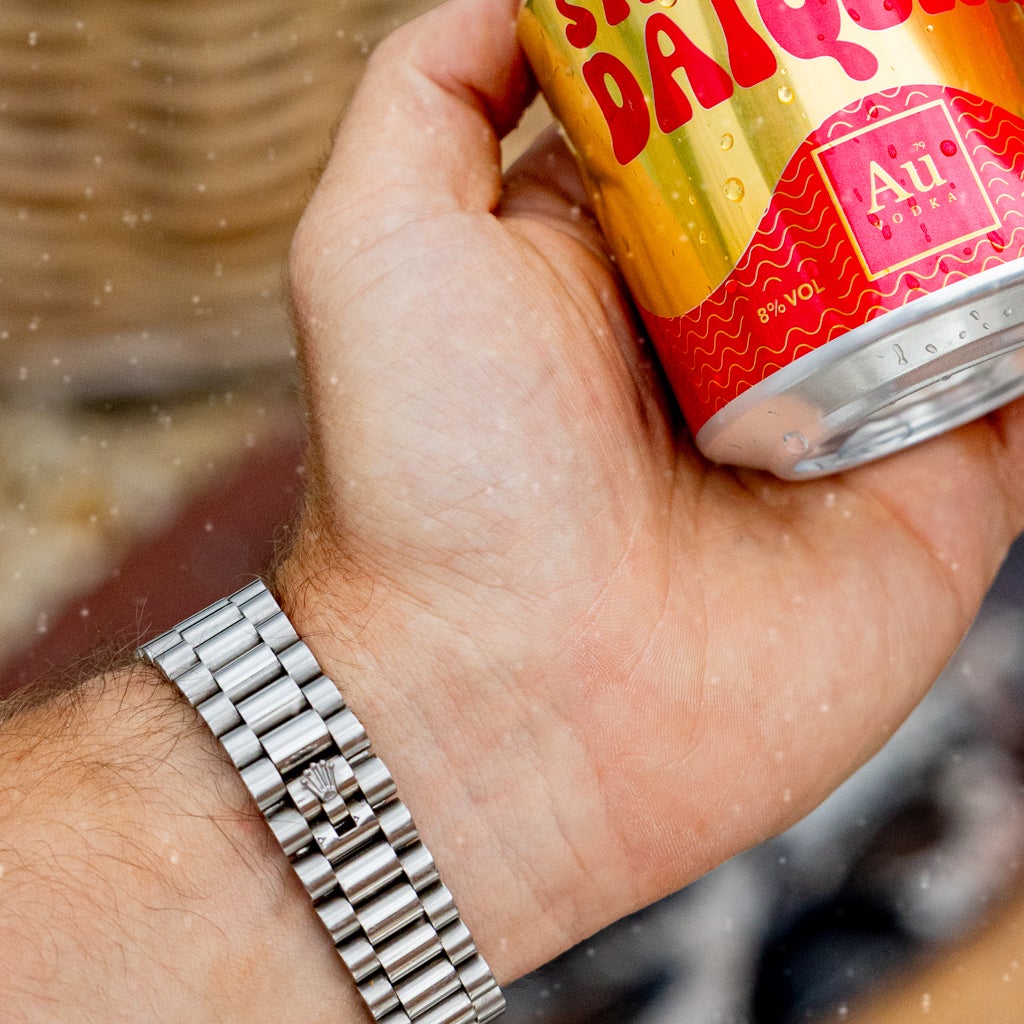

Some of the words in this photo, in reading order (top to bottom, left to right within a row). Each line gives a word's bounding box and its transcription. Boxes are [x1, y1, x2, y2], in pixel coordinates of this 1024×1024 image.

[866, 154, 947, 215] Au
[873, 192, 957, 231] VODKA
[757, 299, 786, 323] 8%
[783, 279, 826, 306] VOL
